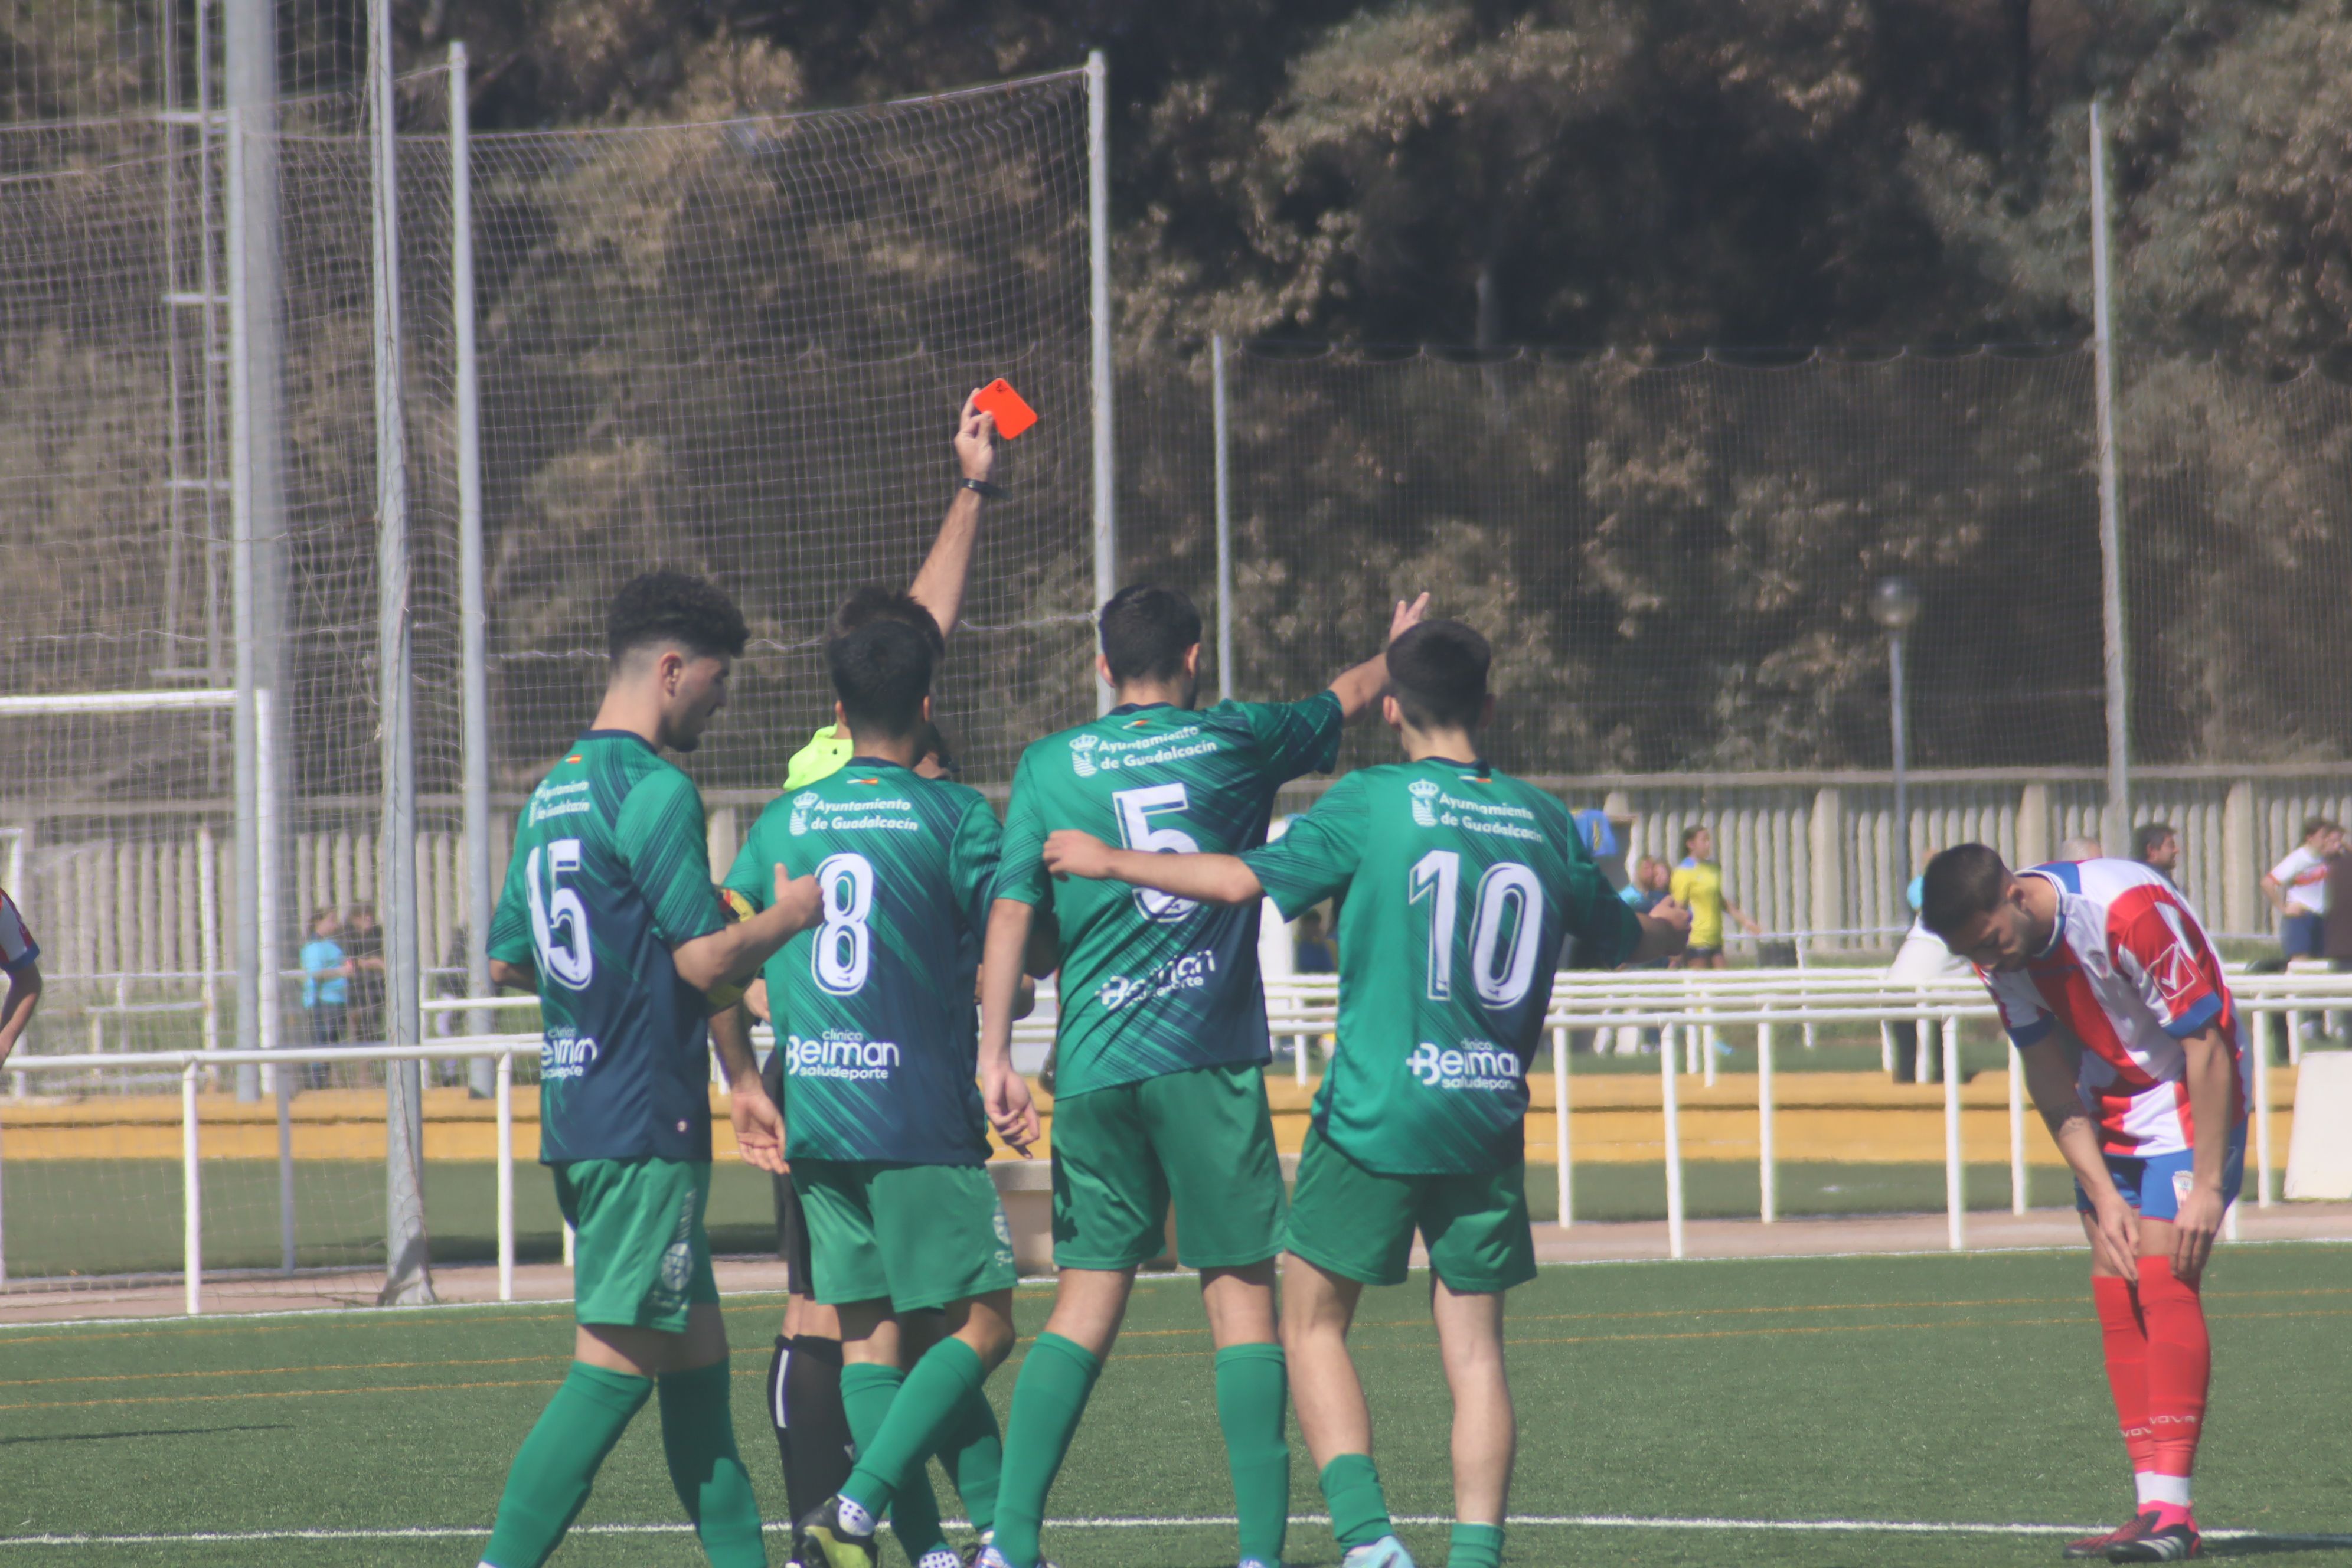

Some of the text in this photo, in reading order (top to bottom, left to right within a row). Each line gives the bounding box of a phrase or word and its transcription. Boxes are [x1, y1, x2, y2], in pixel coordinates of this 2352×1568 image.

[1098, 726, 1200, 753] Ayuntamiento
[1100, 740, 1217, 769] de Guadalcacín
[814, 798, 912, 814] Ayuntamiento
[1440, 811, 1458, 826] de
[811, 815, 918, 831] de Guadalcacín
[1112, 782, 1200, 923] 5
[524, 839, 593, 991] 15
[811, 852, 874, 996] 8
[1409, 850, 1543, 1010] 10
[799, 1064, 888, 1080] saludeporte
